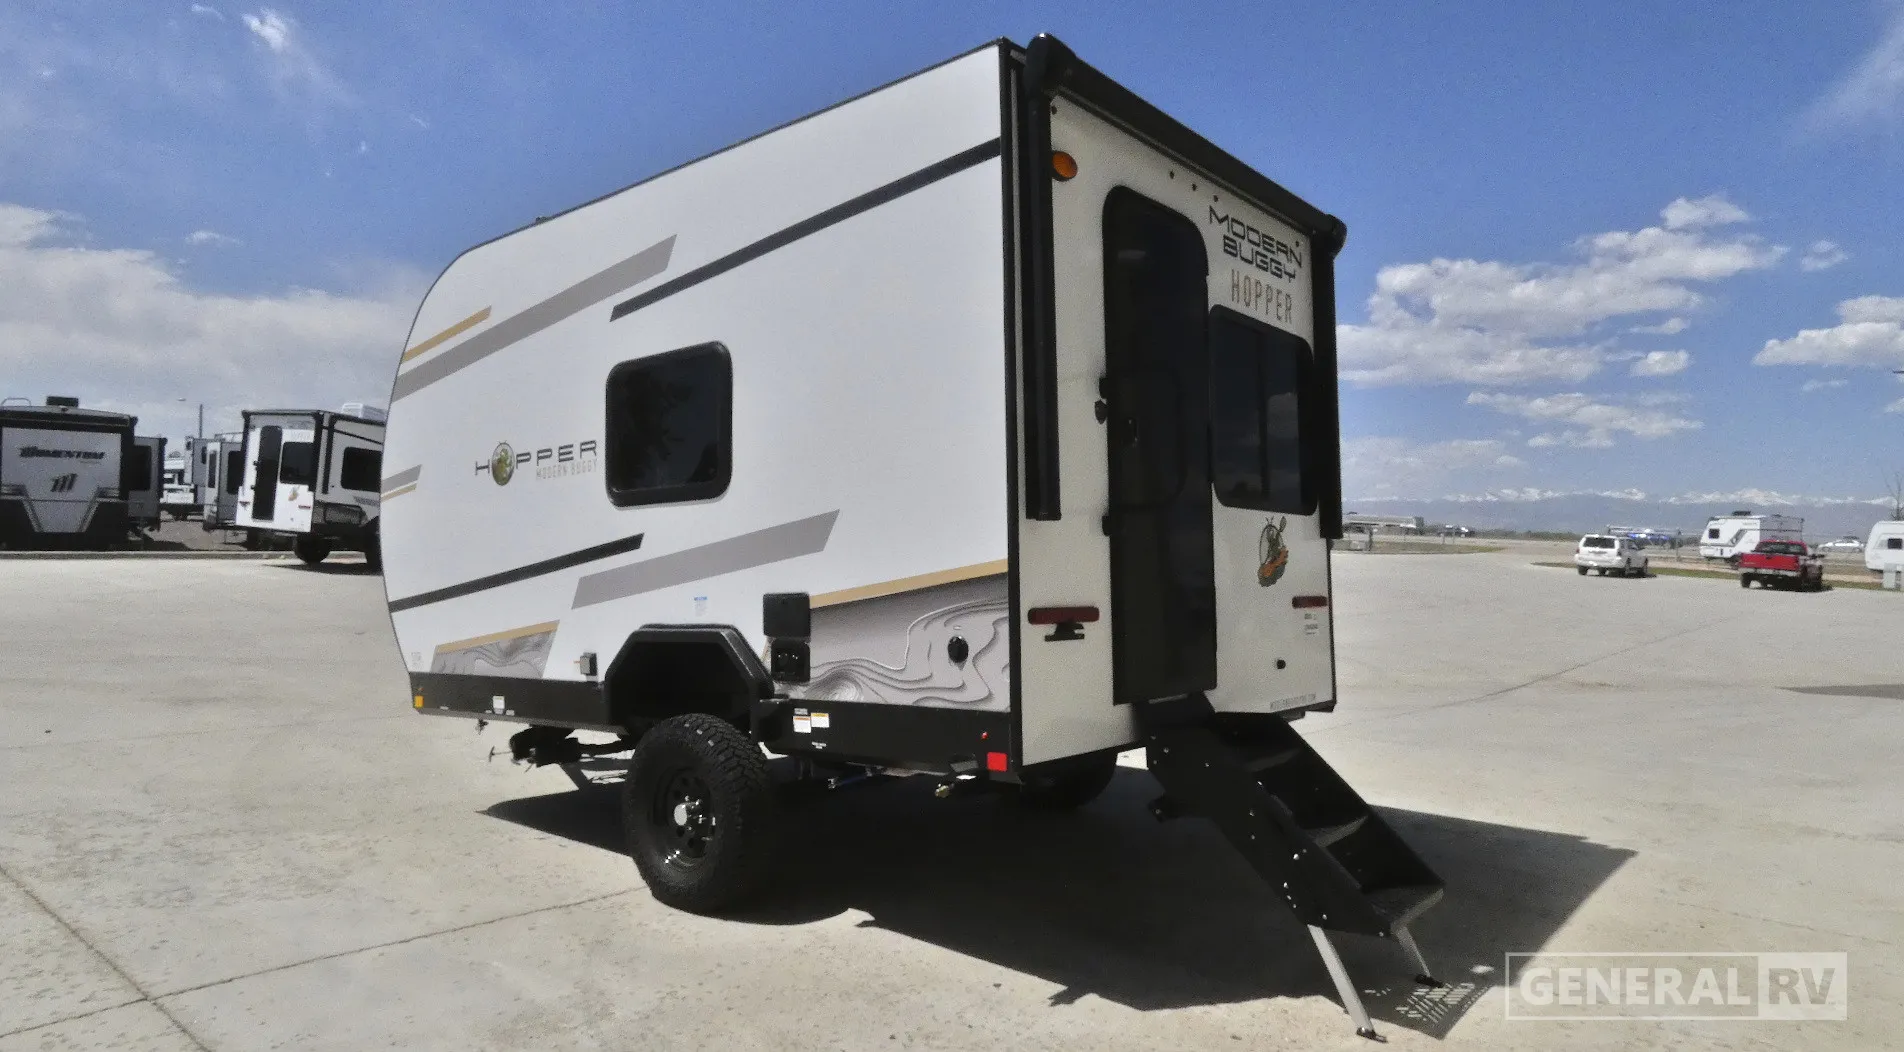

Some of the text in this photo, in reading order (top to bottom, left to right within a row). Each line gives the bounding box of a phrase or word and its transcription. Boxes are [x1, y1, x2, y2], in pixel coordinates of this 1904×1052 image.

[1209, 205, 1302, 268] MODERN
[1223, 234, 1296, 283] BUGGY
[1231, 269, 1292, 324] HOPPER
[537, 459, 599, 480] MODERN BUGGY
